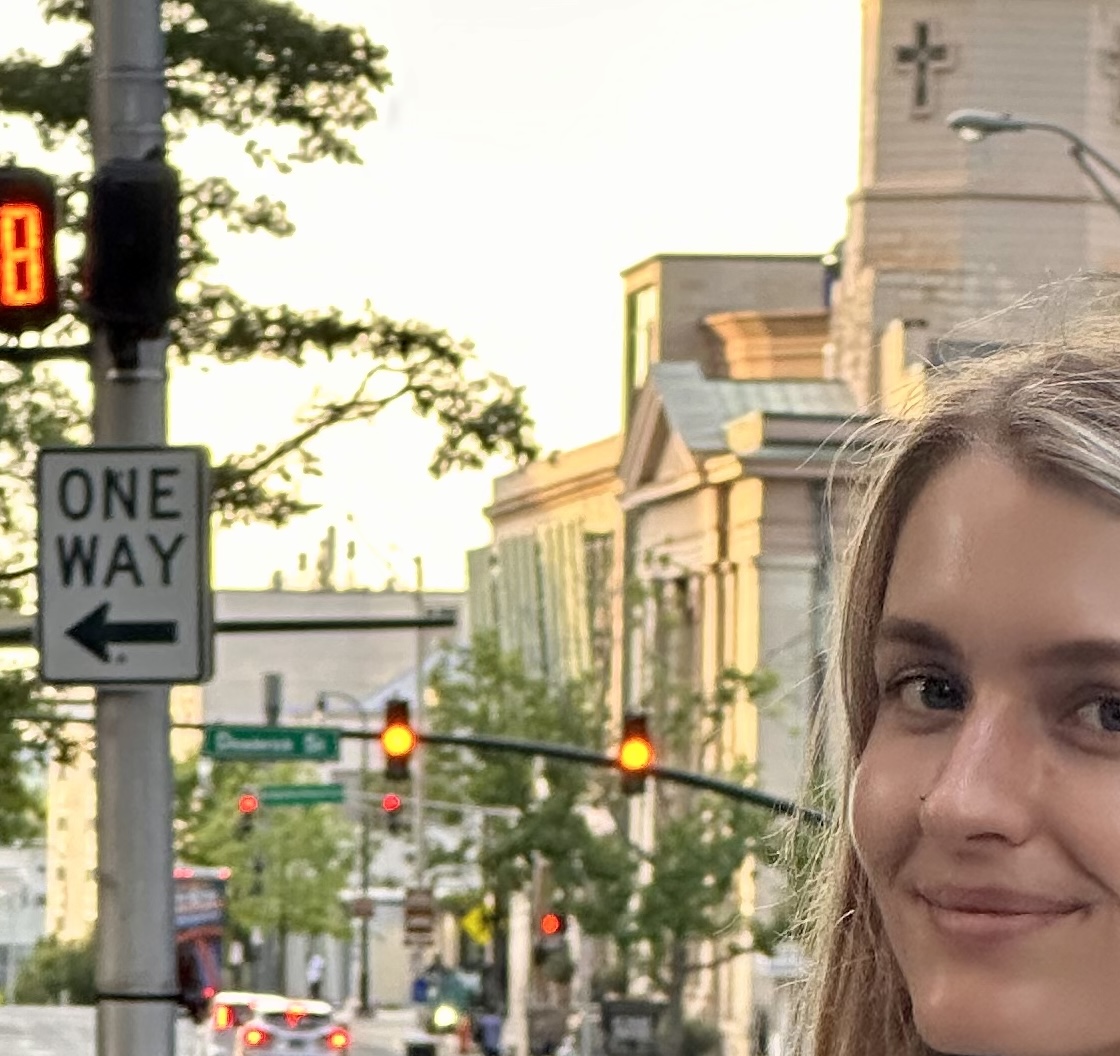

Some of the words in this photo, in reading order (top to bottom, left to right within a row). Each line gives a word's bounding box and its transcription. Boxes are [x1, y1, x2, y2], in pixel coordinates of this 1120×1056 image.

[0, 203, 44, 306] 8
[57, 466, 181, 520] ONE
[56, 534, 187, 587] WAY
